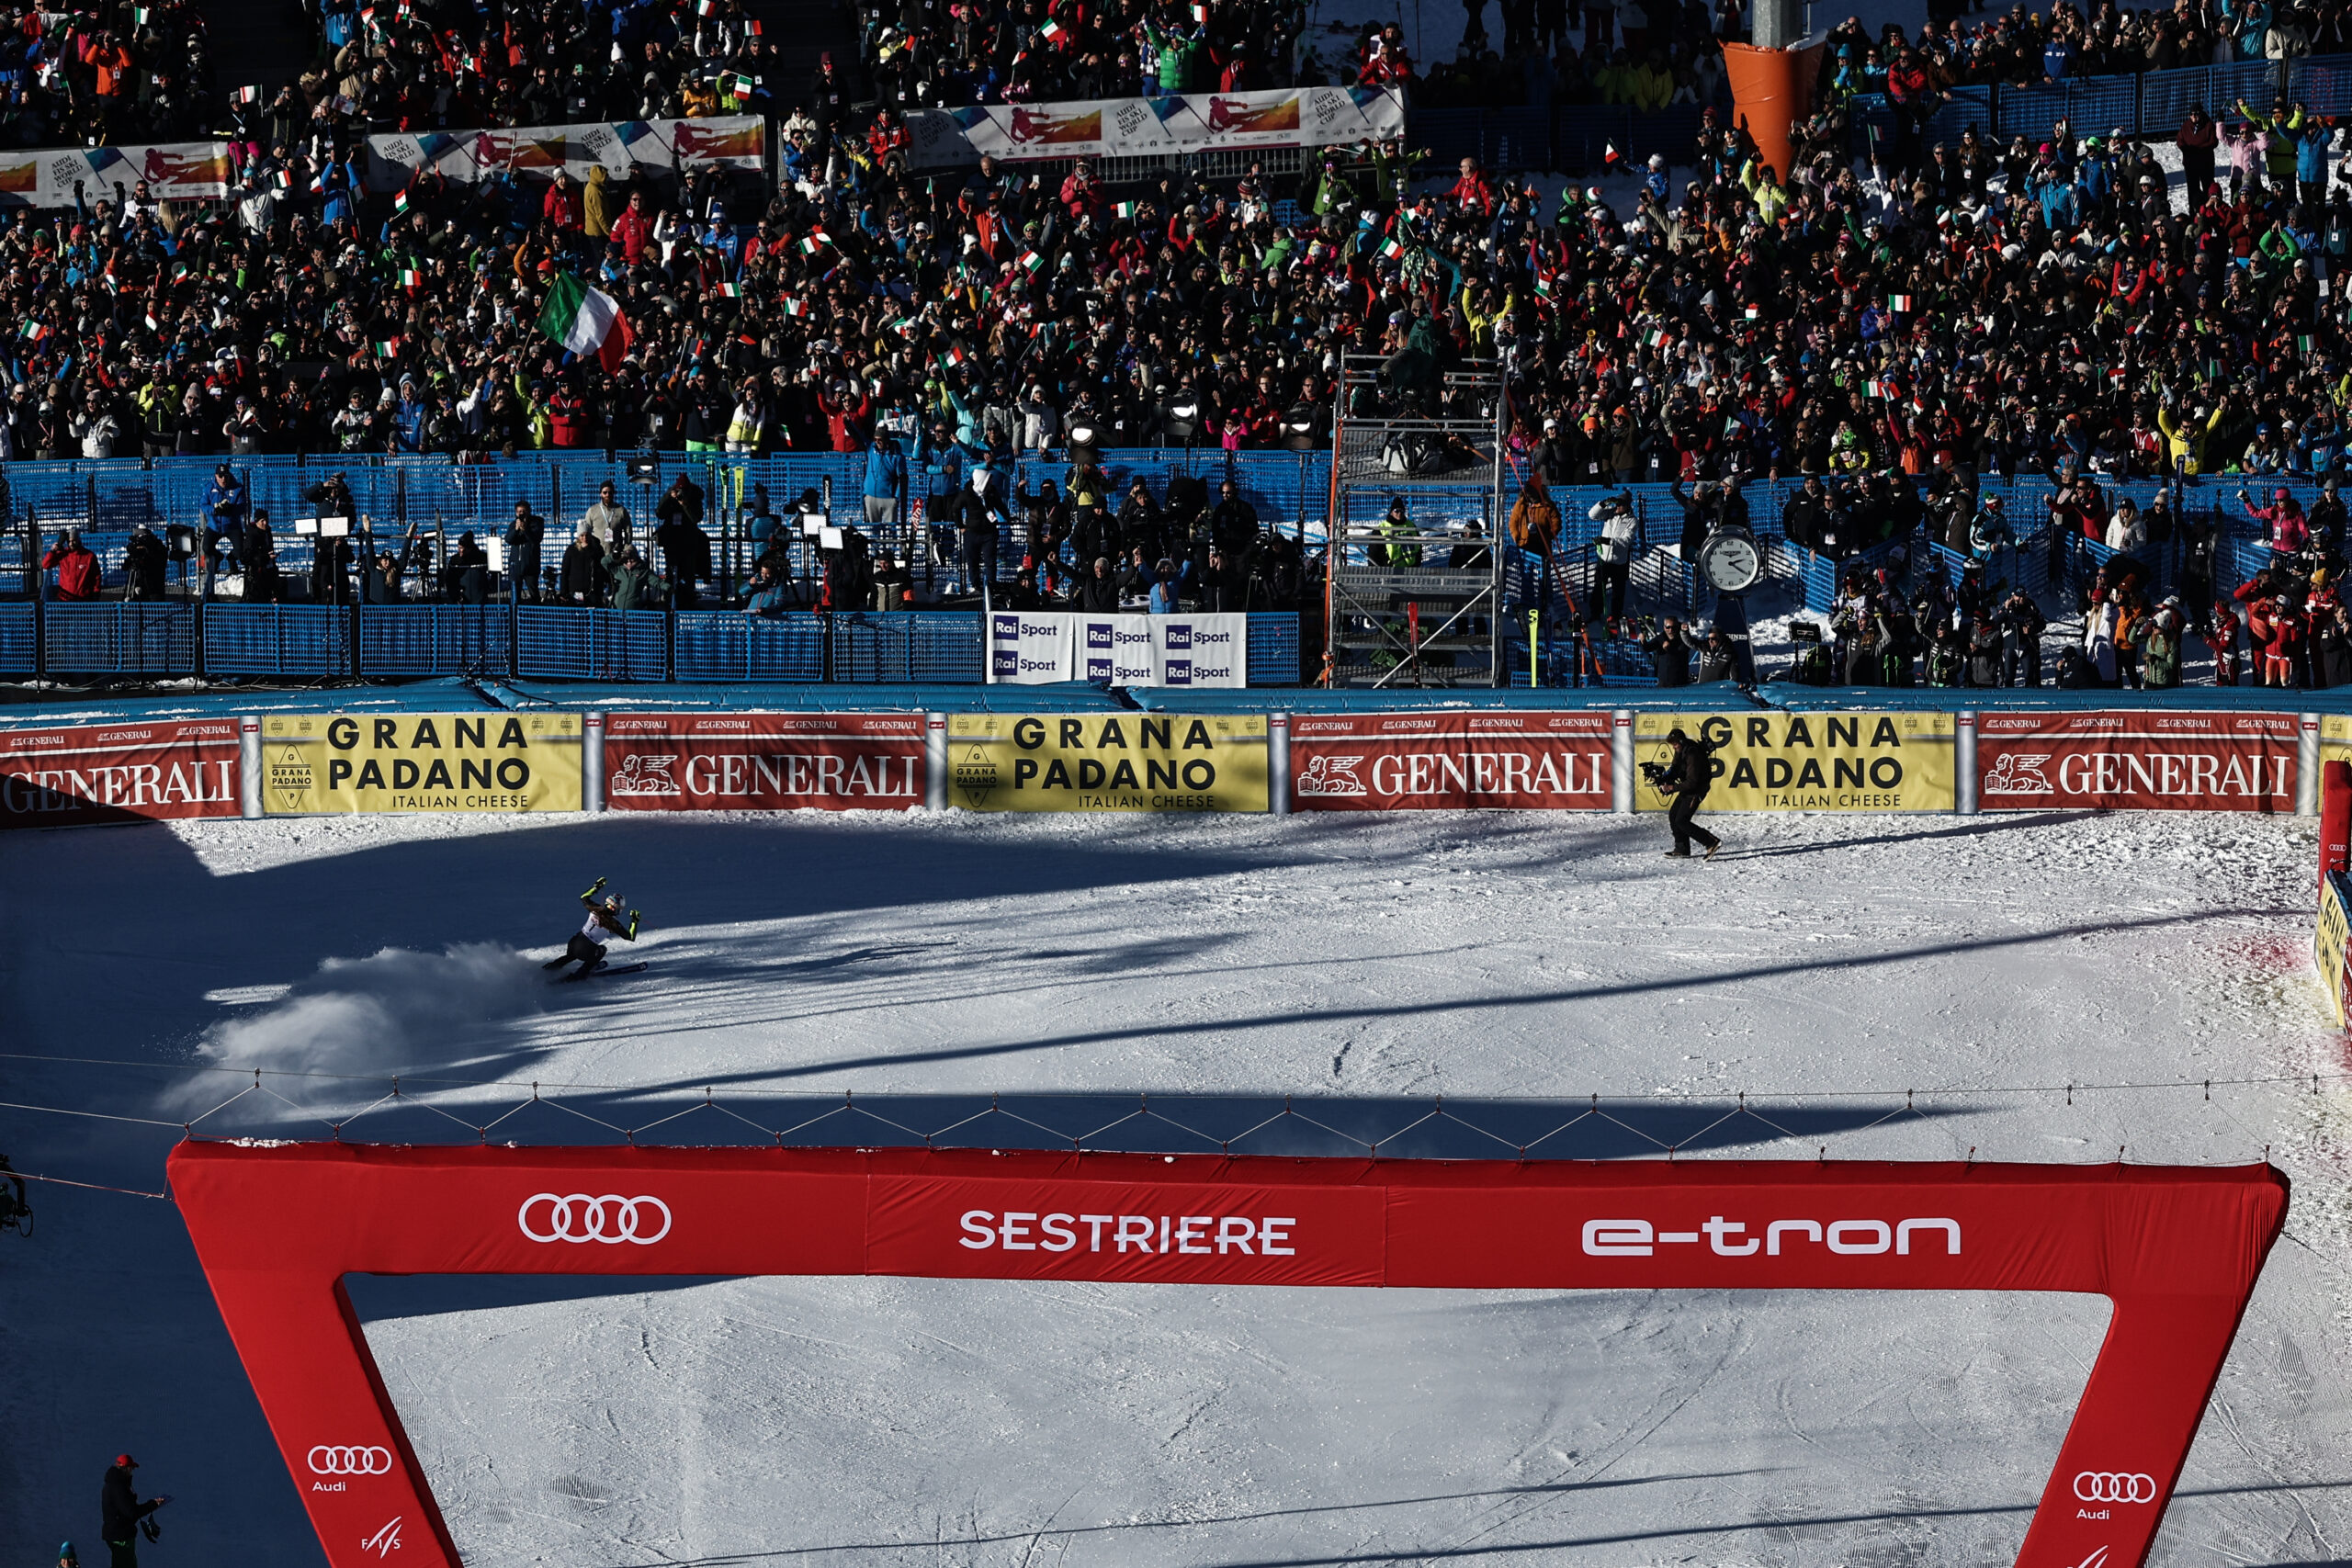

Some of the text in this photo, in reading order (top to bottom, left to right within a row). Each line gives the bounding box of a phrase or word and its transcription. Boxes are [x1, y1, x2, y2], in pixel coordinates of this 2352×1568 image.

[1314, 91, 1333, 105] AUDI
[1328, 96, 1340, 105] SKI
[1117, 103, 1136, 118] AUDI
[1117, 107, 1142, 125] FIS SKI
[1317, 101, 1345, 118] WORLD
[1119, 114, 1147, 130] WORLD
[1320, 113, 1335, 125] CUP
[581, 129, 600, 142] AUDI
[1122, 125, 1137, 136] CUP
[384, 140, 402, 152] AUDI
[51, 155, 71, 169] AUDI
[65, 160, 77, 169] SKI
[54, 165, 83, 182] WORLD
[57, 176, 72, 187] CUP
[996, 622, 1057, 636] Rai Sport
[1090, 630, 1151, 644] Rai Sport
[1169, 632, 1229, 644] Rai Sport
[996, 658, 1056, 671] Rai Sport
[1090, 665, 1151, 679] Rai Sport
[1169, 666, 1229, 679] Rai Sport
[627, 721, 667, 729] GENERALI
[709, 720, 750, 729] GENERALI
[796, 720, 837, 729] GENERALI
[875, 721, 917, 729] GENERALI
[1395, 720, 1436, 729] GENERALI
[1482, 718, 1523, 728] GENERALI
[1562, 718, 1602, 728] GENERALI
[2082, 718, 2124, 728] GENERALI
[2170, 718, 2211, 728] GENERALI
[2248, 719, 2290, 729] GENERALI
[110, 730, 151, 740] GENERALI
[189, 726, 230, 735] GENERALI
[327, 717, 527, 750] GRANA
[1012, 717, 1214, 750] GRANA
[1702, 716, 1901, 748] GRANA
[23, 736, 64, 746] GENERALI
[330, 758, 530, 790] PADANO
[685, 754, 918, 796] GENERALI
[1014, 758, 1216, 790] PADANO
[1372, 753, 1604, 795] GENERALI
[2059, 753, 2290, 796] GENERALI
[4, 761, 235, 814] GENERALI
[393, 795, 528, 807] ITALIAN CHEESE
[1079, 795, 1215, 807] ITALIAN CHEESE
[1766, 794, 1901, 807] ITALIAN CHEESE
[958, 1210, 1296, 1256] SESTRIERE
[1582, 1216, 1961, 1257] e-tron
[312, 1481, 345, 1492] Audi
[2076, 1508, 2109, 1519] Audi
